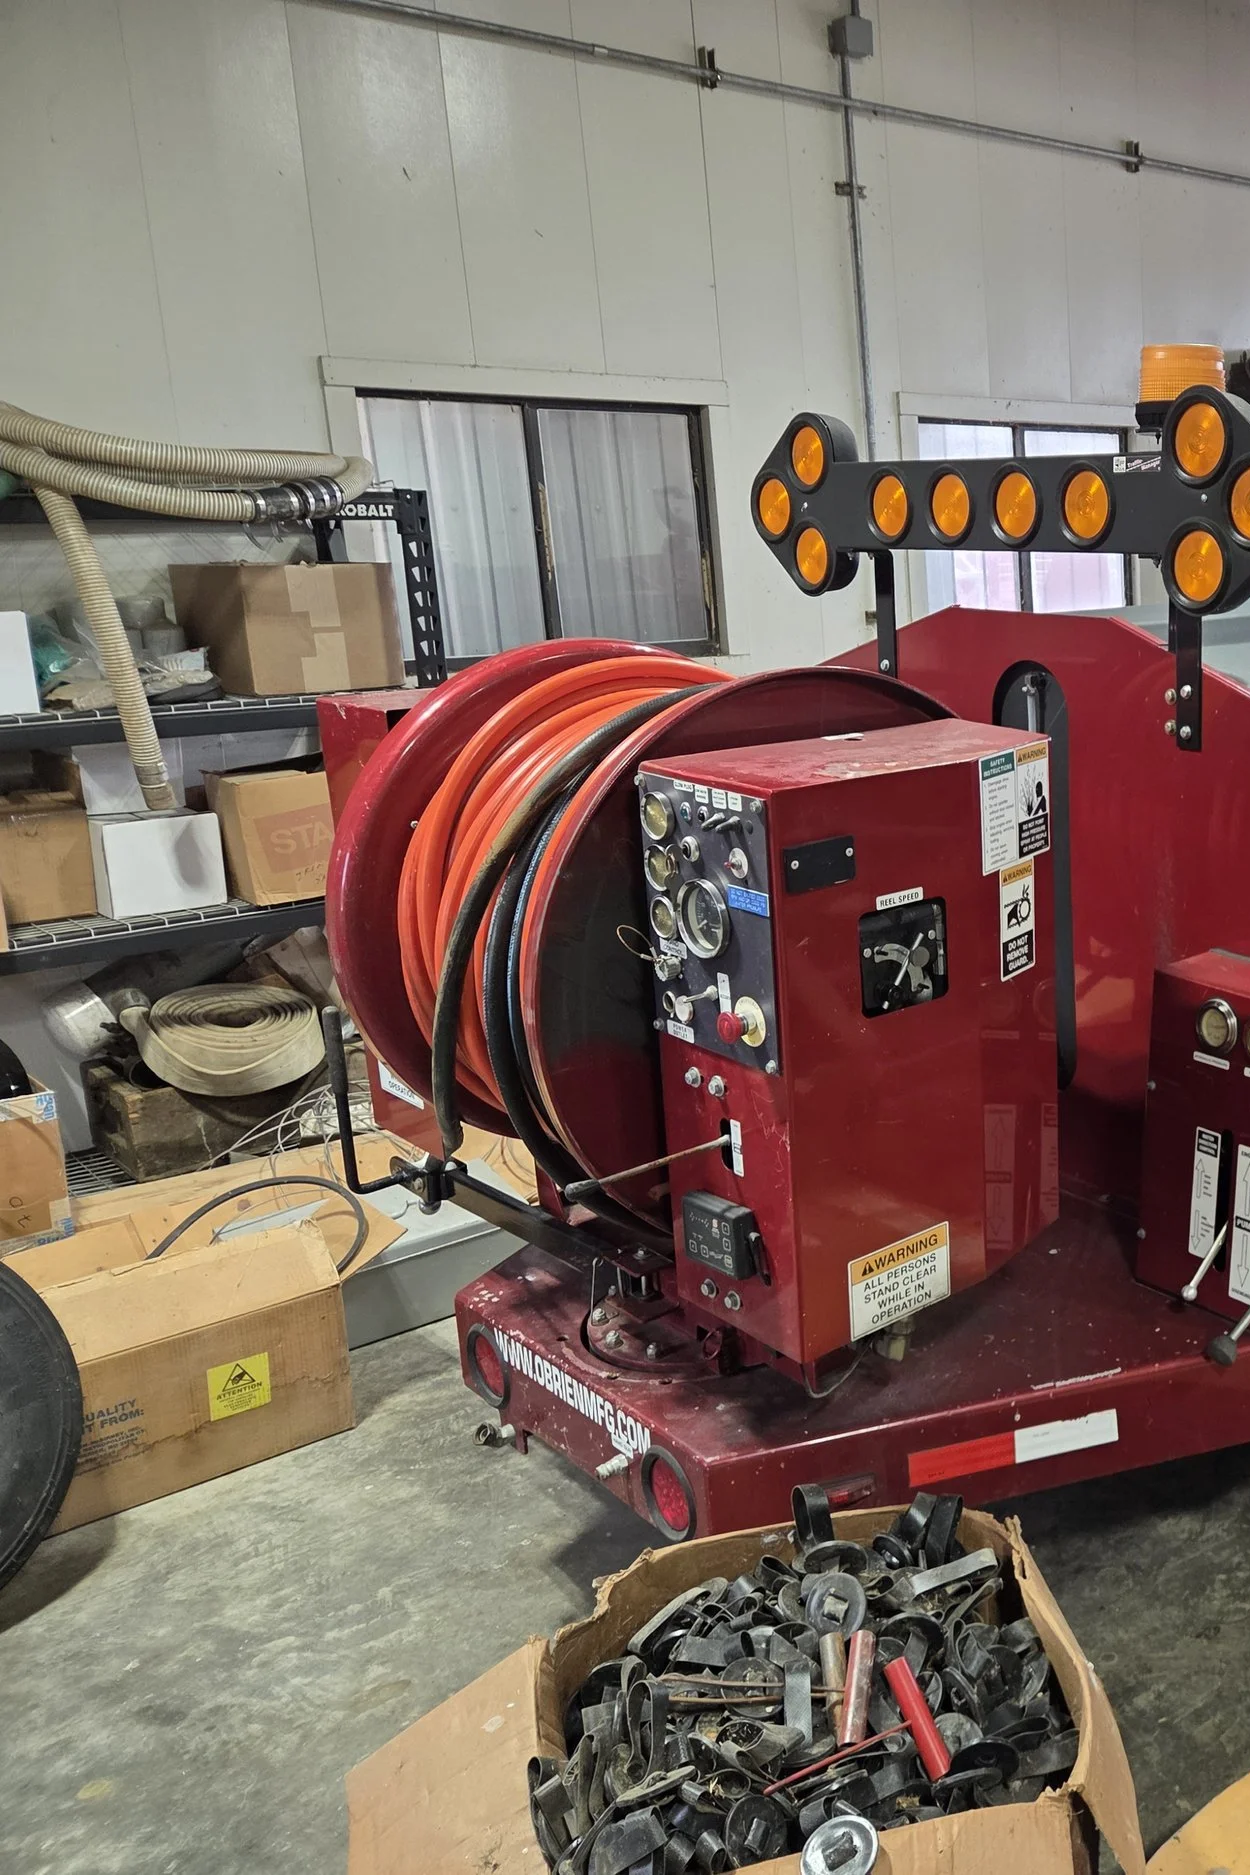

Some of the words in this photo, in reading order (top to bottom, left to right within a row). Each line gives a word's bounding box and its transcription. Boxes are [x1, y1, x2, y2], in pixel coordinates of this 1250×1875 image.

[1022, 746, 1047, 760] WARNING
[983, 764, 1013, 778] INSTRUCTIONS
[990, 757, 1005, 768] SAFETY
[1007, 865, 1032, 880] WARNING
[880, 898, 896, 907] REEL
[898, 891, 919, 903] SPEED
[1008, 941, 1017, 951] DO
[1017, 935, 1028, 946] NOT
[1007, 945, 1028, 962] REMOVE
[1008, 955, 1028, 971] GUARD.
[874, 1233, 938, 1270] WARNING
[864, 1276, 884, 1292] ALL
[887, 1252, 936, 1281] PERSONS
[864, 1281, 899, 1304] STAND
[902, 1264, 937, 1286] CLEAR
[877, 1288, 911, 1309] WHILE
[914, 1281, 925, 1292] IN
[871, 1290, 932, 1324] OPERATION
[217, 1381, 263, 1400] ATTENTION
[85, 1398, 136, 1422] UALITY
[99, 1407, 145, 1429] FROM:
